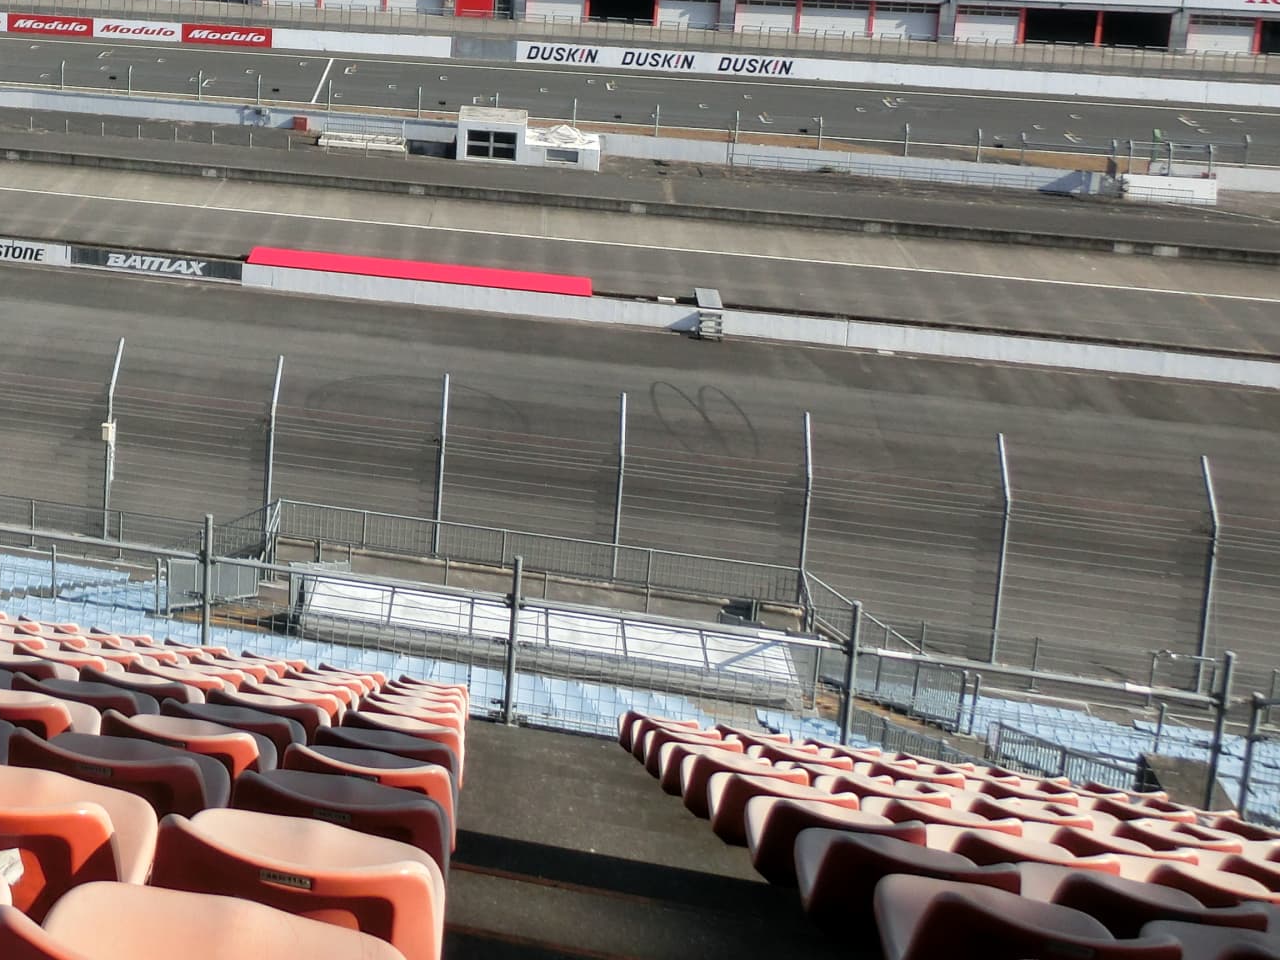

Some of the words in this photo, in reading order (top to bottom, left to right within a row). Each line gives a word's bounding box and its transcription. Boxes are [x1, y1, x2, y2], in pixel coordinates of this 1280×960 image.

[13, 19, 88, 33] Modulo
[100, 24, 176, 38] Modulo
[187, 29, 266, 43] Modulo
